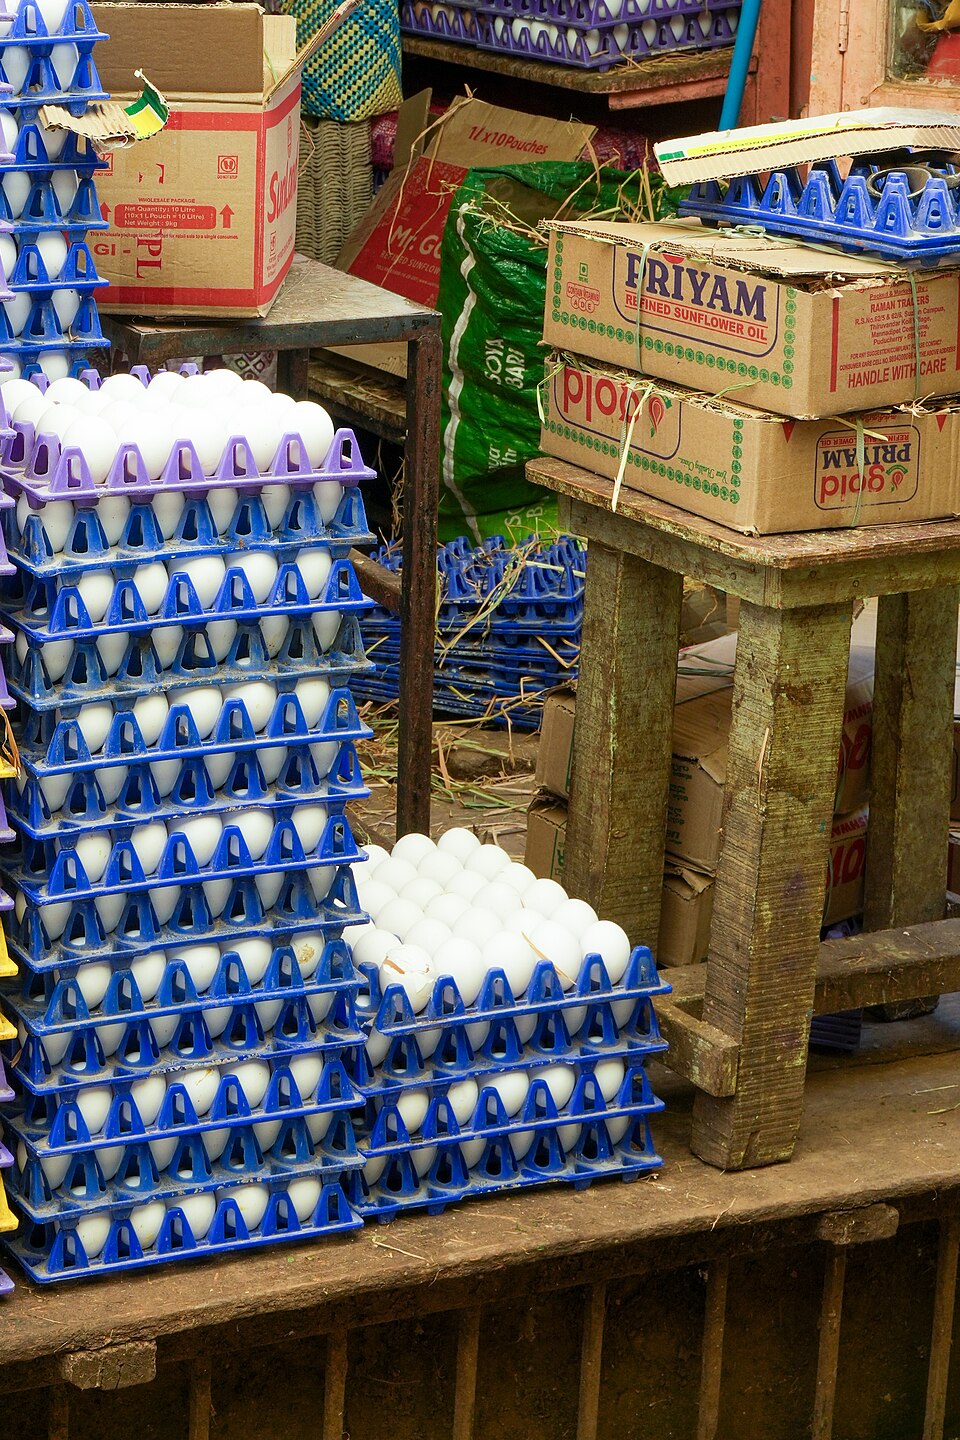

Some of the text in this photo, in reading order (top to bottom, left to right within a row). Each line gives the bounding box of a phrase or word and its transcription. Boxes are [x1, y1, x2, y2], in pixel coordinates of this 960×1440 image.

[94, 244, 115, 255] GI
[625, 252, 767, 322] PRIYAM
[625, 293, 767, 341] REFINED SUNFLOWER OIL
[870, 301, 896, 313] RAMAN
[923, 306, 945, 315] Campus,
[873, 335, 903, 345] Puducherry
[485, 339, 504, 385] SOYA
[848, 358, 947, 388] HANDLE WITH CARE
[820, 464, 885, 503] gold
